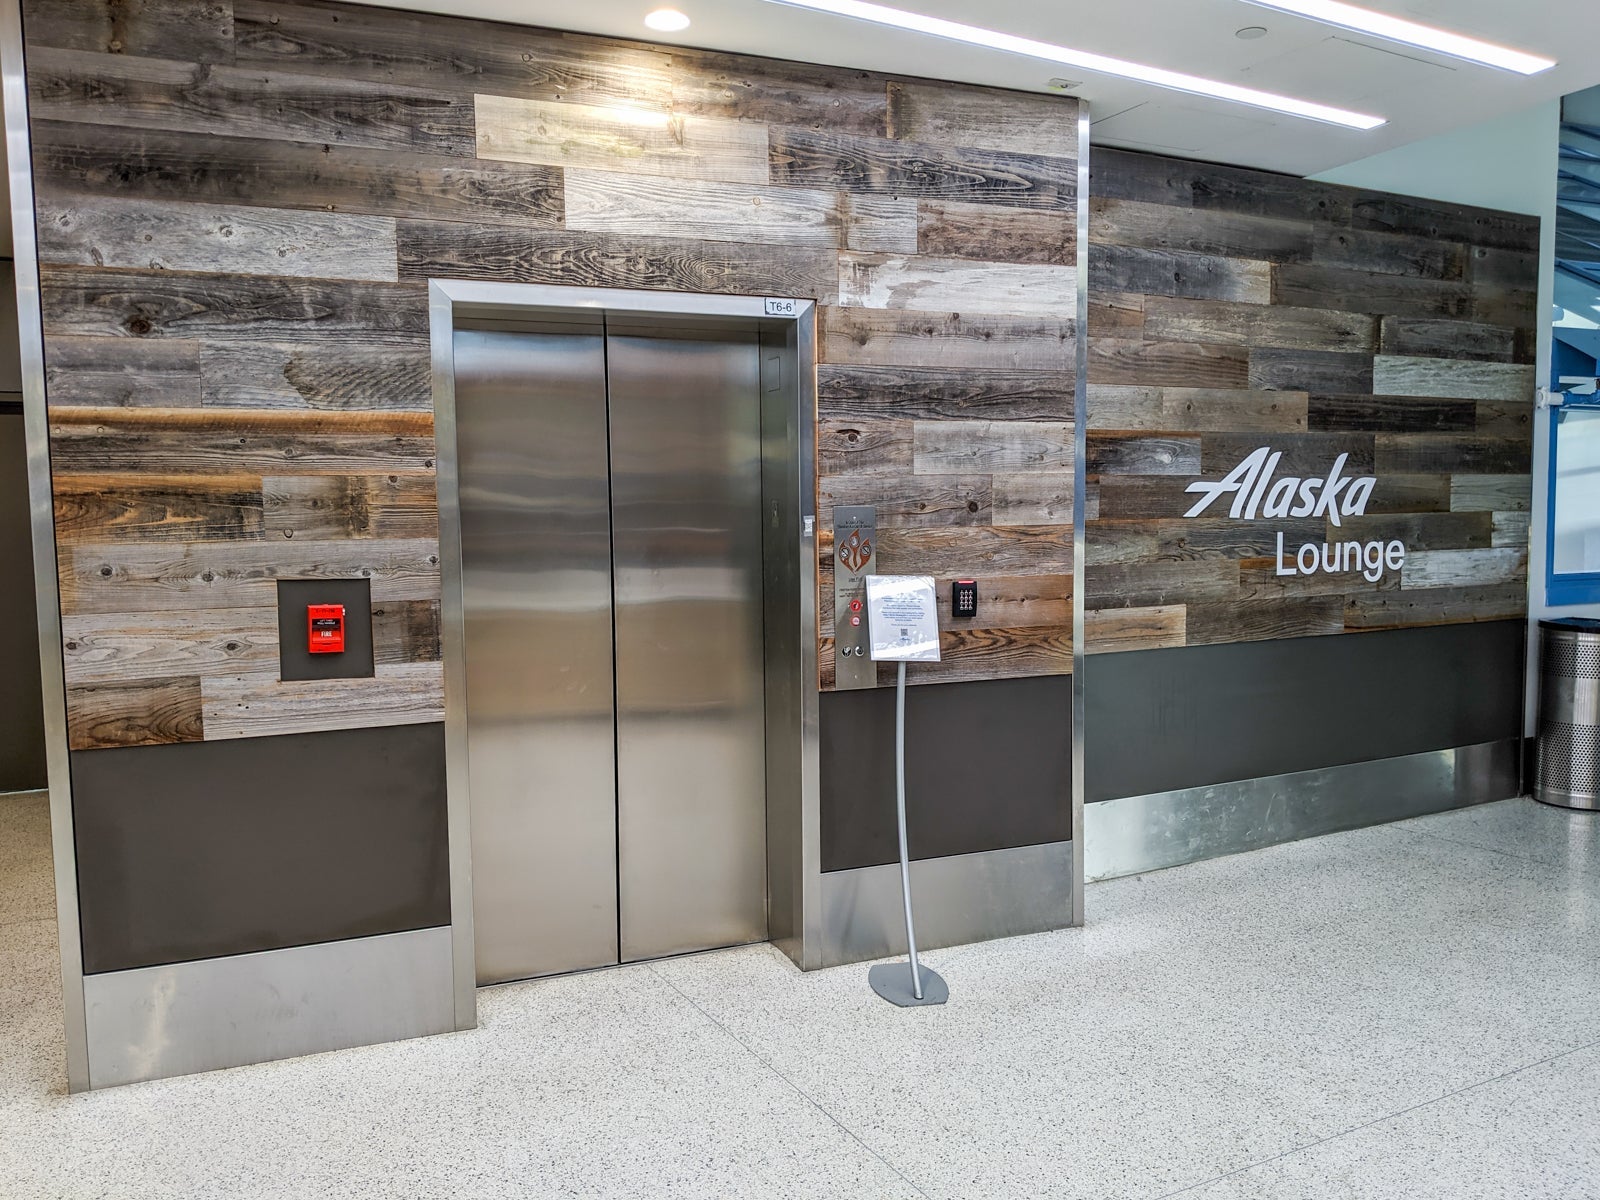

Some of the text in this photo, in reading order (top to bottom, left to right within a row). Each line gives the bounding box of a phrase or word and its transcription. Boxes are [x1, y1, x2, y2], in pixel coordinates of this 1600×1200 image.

[769, 301, 792, 313] T6-6
[1183, 446, 1377, 527] Alaska
[1276, 531, 1405, 583] Lounge
